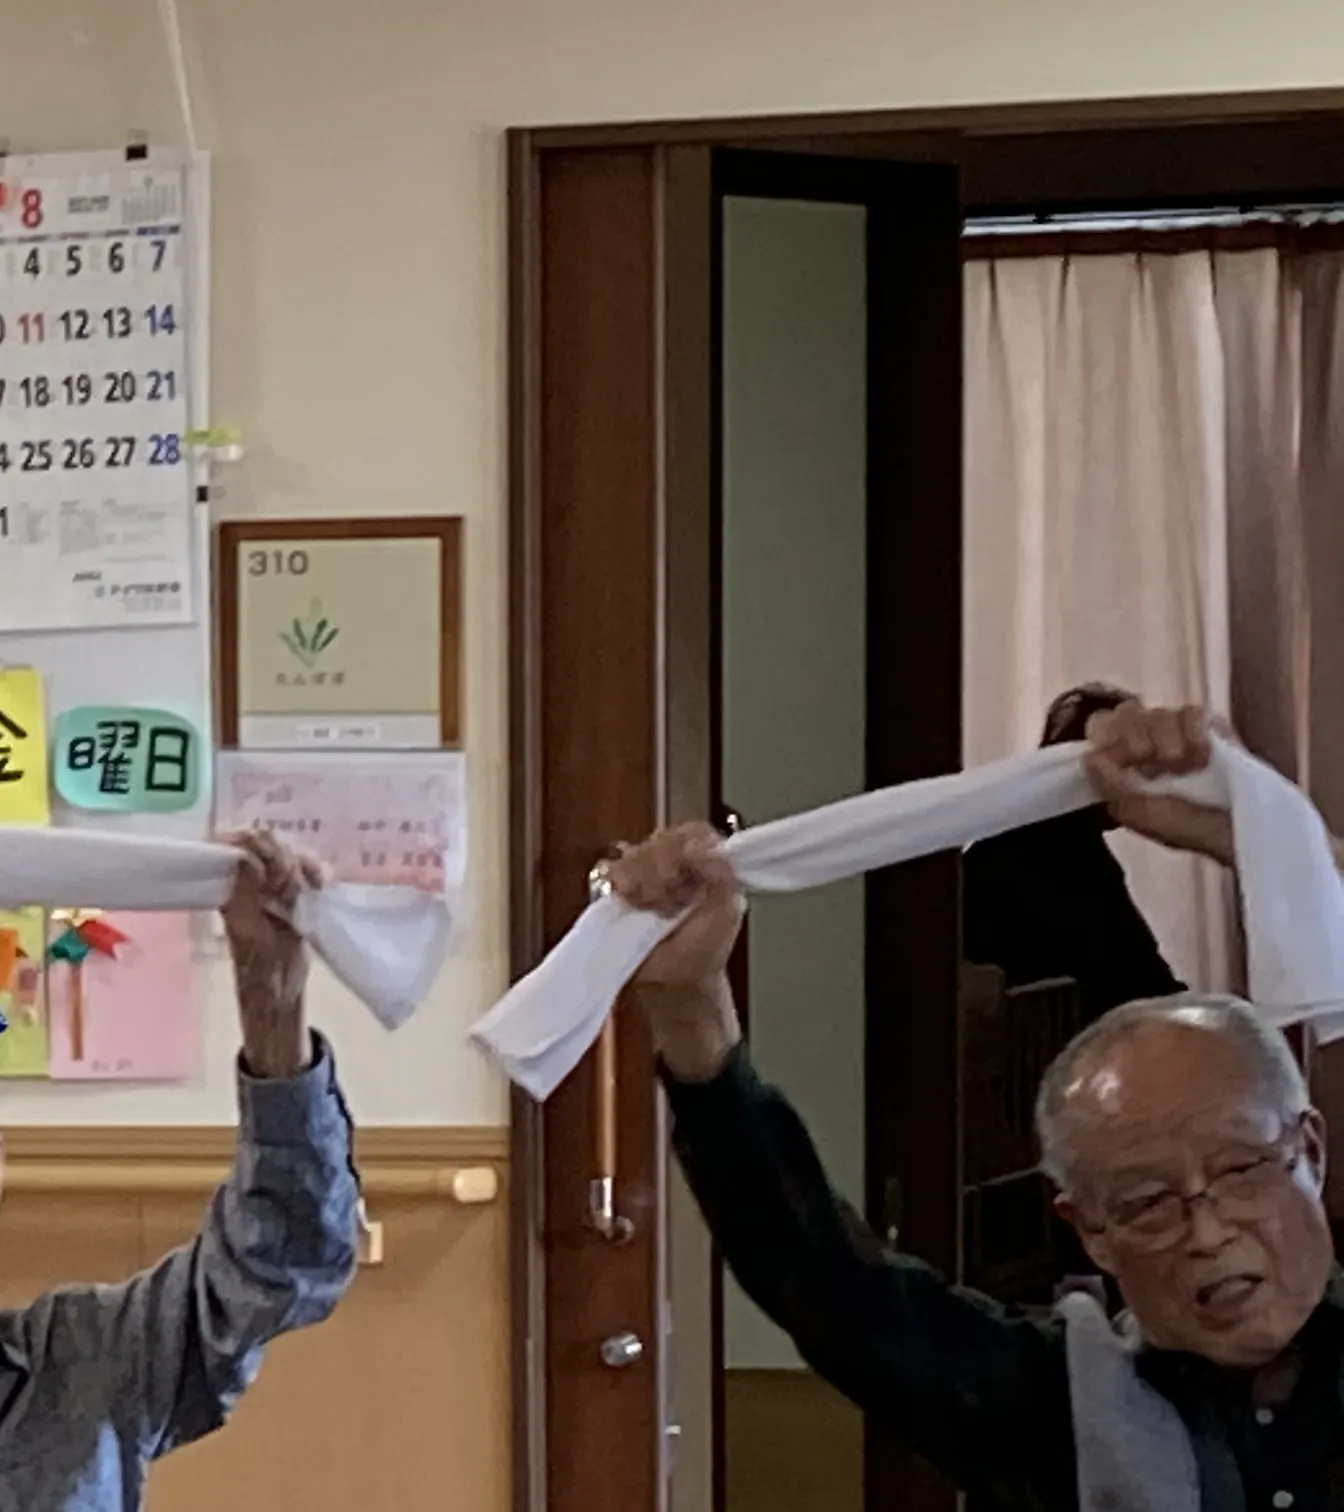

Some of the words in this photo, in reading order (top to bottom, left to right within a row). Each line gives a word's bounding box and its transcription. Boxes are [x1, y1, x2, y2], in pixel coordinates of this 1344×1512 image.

[21, 188, 45, 230] 8
[23, 247, 40, 278] 4
[66, 245, 82, 276] 5
[108, 242, 124, 274] 6
[151, 240, 167, 272] 7
[18, 312, 45, 344] 11
[59, 308, 90, 342] 12
[103, 307, 132, 339] 13
[145, 304, 176, 336] 14
[20, 376, 50, 408] 18
[63, 374, 92, 406] 19
[104, 371, 136, 403] 20
[147, 370, 176, 401] 21
[21, 440, 53, 472] 25
[63, 438, 95, 470] 26
[105, 436, 136, 468] 27
[147, 433, 182, 466] 28
[247, 550, 309, 577] 310
[69, 720, 190, 795] 曜日
